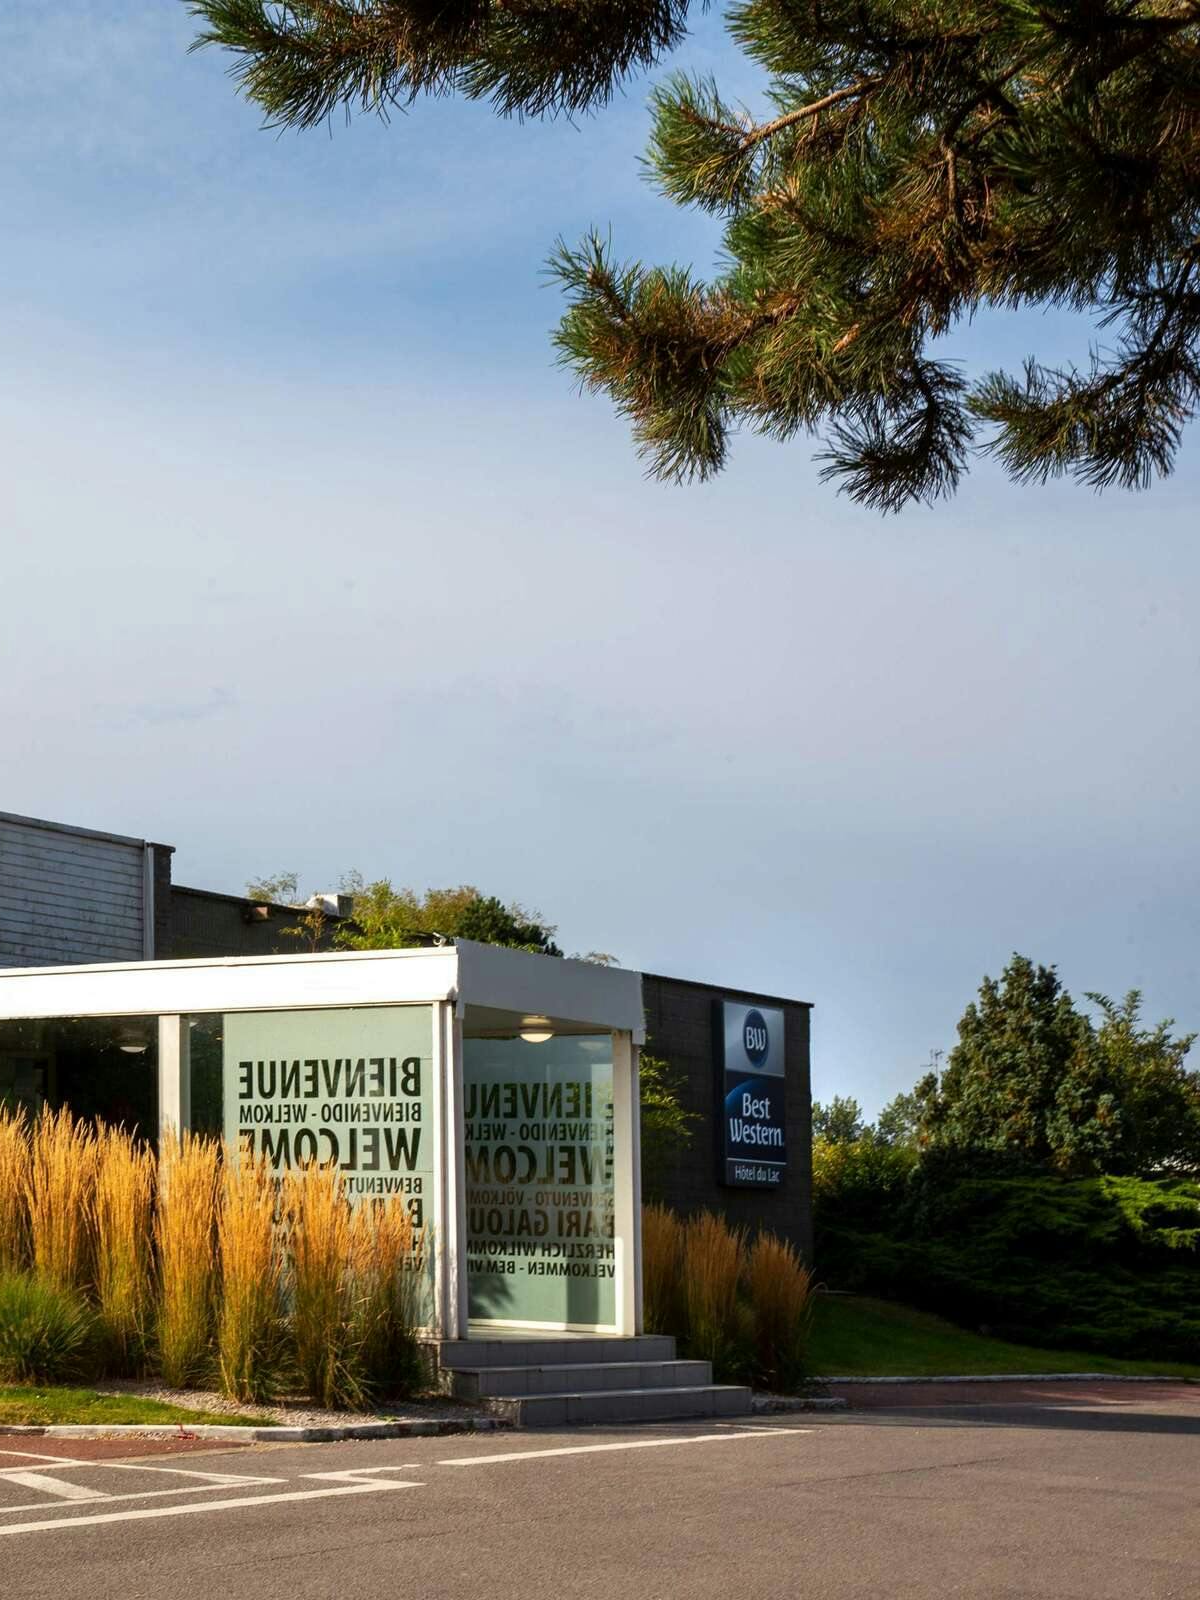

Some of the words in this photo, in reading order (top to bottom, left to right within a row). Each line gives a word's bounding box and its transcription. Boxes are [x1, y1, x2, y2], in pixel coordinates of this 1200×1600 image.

[746, 1026, 766, 1051] BW
[742, 1093, 771, 1120] Best
[729, 1118, 783, 1147] Western
[735, 1165, 756, 1181] Hôtel
[757, 1167, 767, 1181] du
[768, 1169, 780, 1182] Lac
